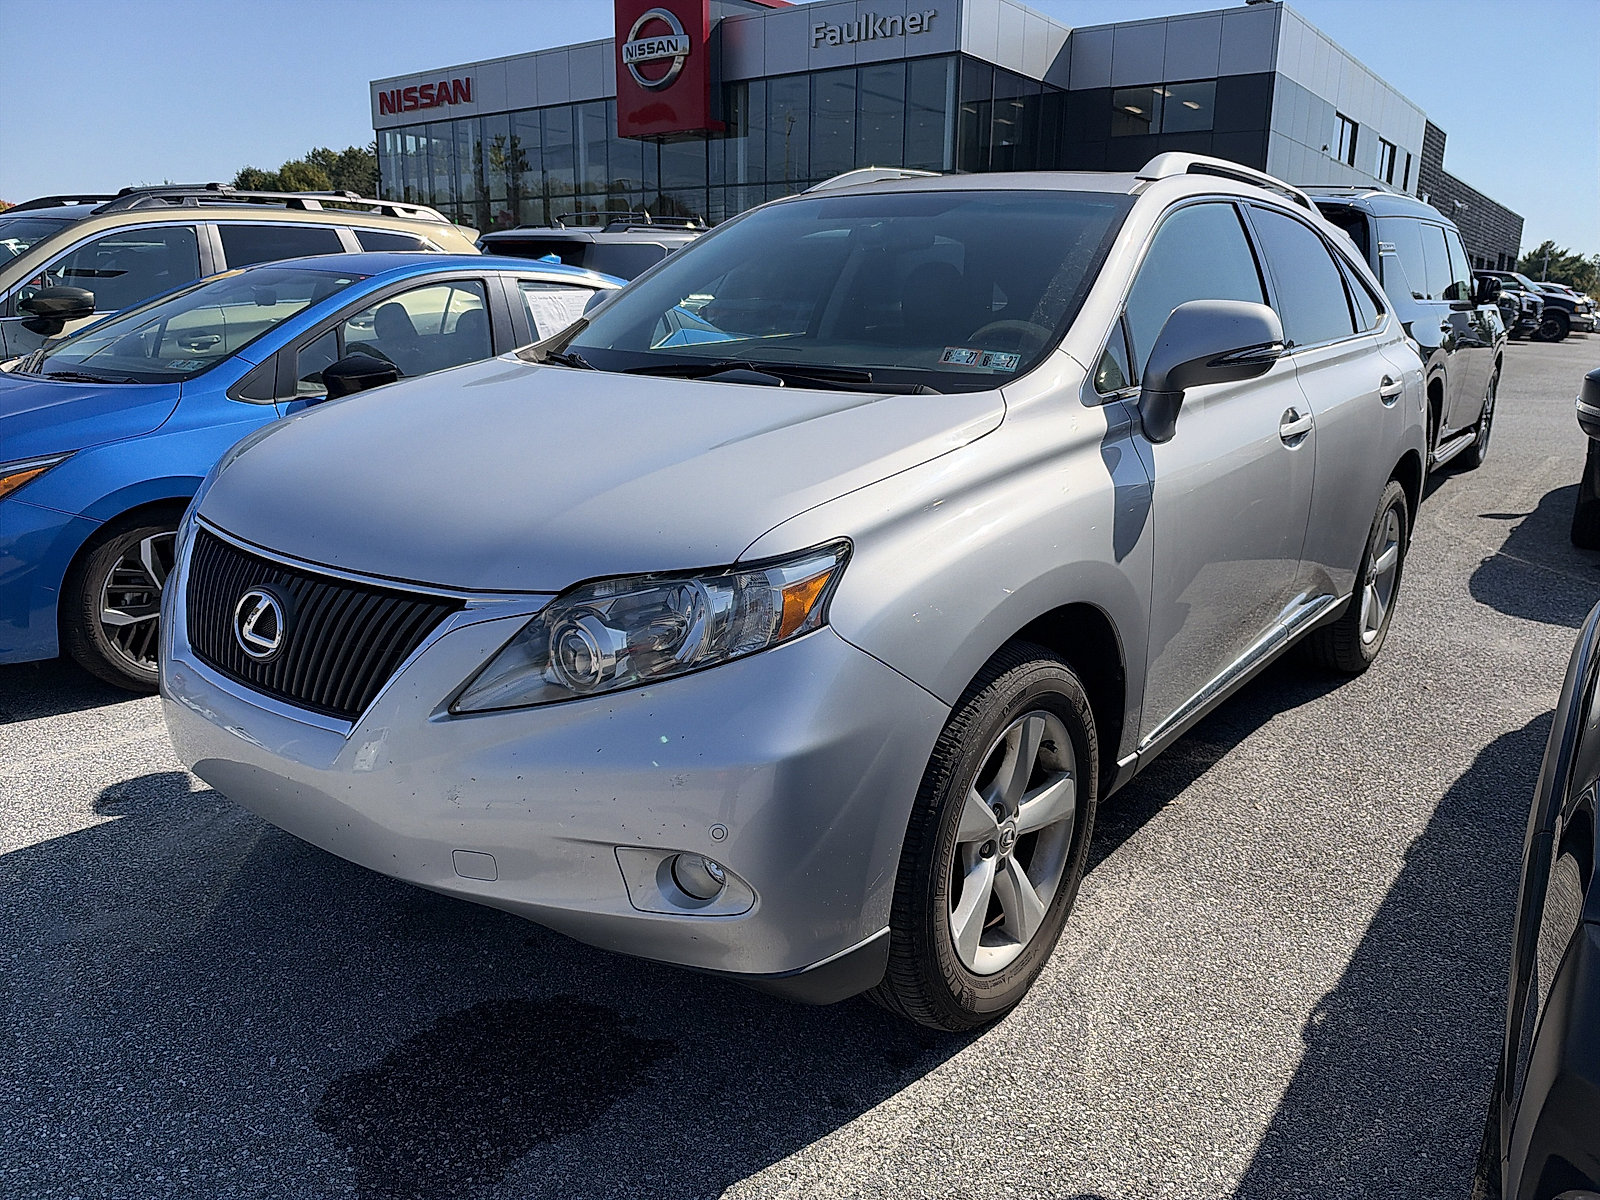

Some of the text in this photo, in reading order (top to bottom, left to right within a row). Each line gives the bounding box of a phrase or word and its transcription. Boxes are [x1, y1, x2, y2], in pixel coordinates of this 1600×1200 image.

[811, 9, 936, 48] Faulkner
[625, 38, 679, 59] NISSAN
[378, 77, 472, 115] NISSAN
[965, 351, 978, 364] 27
[1005, 355, 1018, 369] 27
[933, 900, 963, 997] MICHELIN
